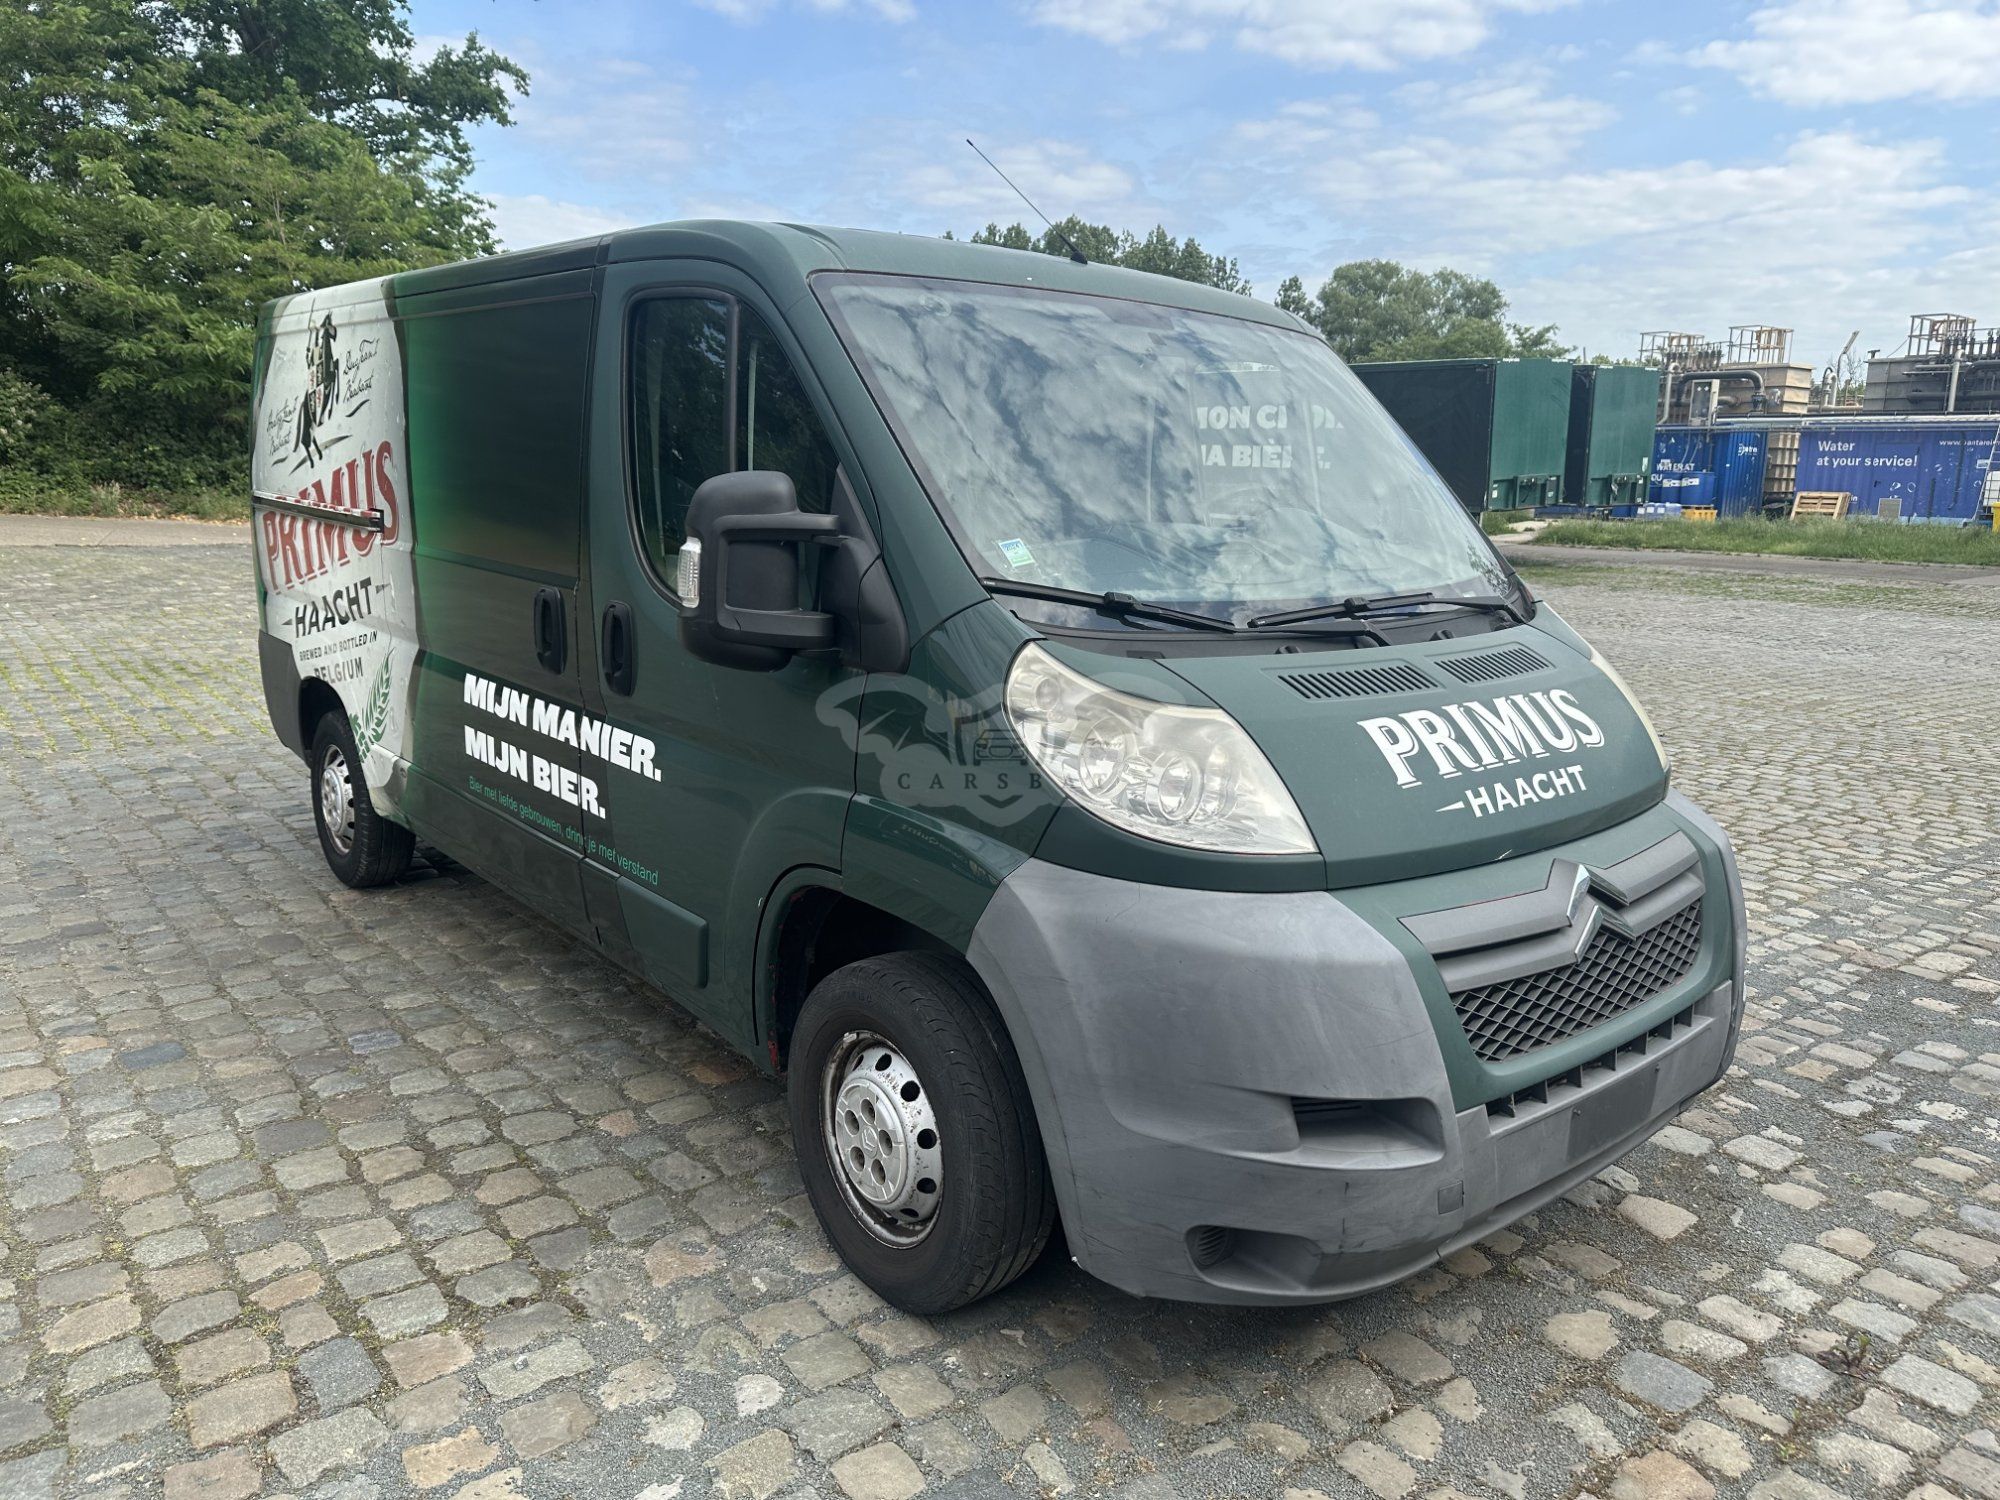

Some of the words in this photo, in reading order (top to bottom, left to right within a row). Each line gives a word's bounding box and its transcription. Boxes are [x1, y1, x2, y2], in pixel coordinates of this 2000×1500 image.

[1816, 457, 1830, 467] at
[1832, 456, 1862, 468] your
[1864, 454, 1918, 468] service!
[1818, 440, 1856, 452] Water
[262, 440, 399, 596] PRIMUS
[295, 576, 373, 638] HAACHT
[299, 646, 322, 662] BREWED
[323, 643, 338, 656] AND
[339, 633, 368, 653] BOTTLED
[369, 629, 378, 643] IN
[313, 656, 364, 684] BELGIUM
[463, 673, 530, 727] MIJN
[532, 698, 662, 783] MANIER.
[1356, 688, 1605, 790] PRIMUS
[463, 725, 529, 783] MIJN
[533, 754, 606, 820] BIER.
[1464, 764, 1588, 818] HAACHT
[468, 775, 483, 793] Bier
[484, 786, 498, 802] met
[587, 834, 597, 854] je
[598, 844, 617, 863] met
[616, 853, 660, 886] verstand
